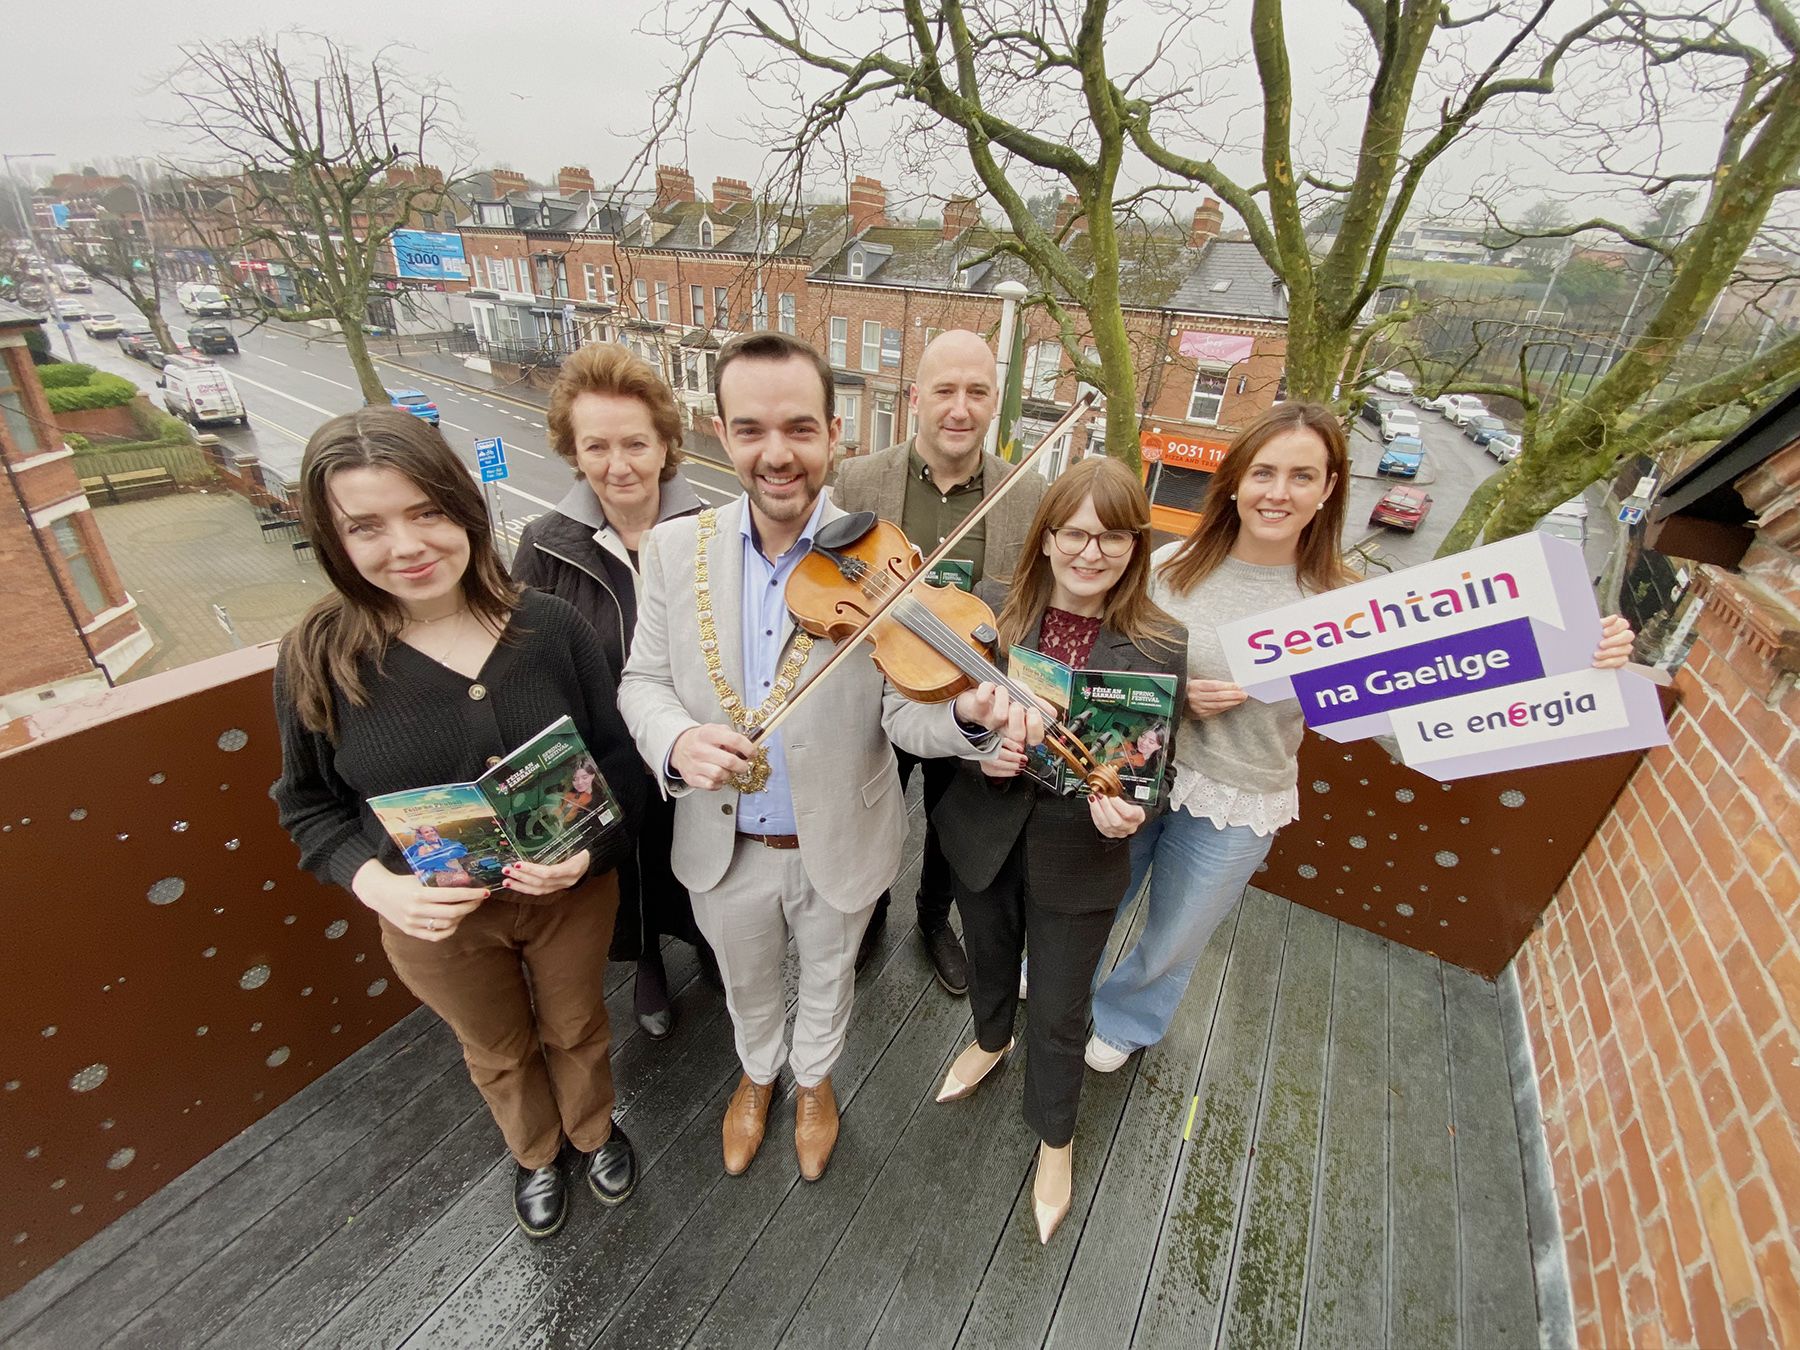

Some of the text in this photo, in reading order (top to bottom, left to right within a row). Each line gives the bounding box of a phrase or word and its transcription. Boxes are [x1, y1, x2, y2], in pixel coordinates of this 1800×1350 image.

[407, 253, 440, 266] 1000
[1165, 454, 1184, 462] PIZZA
[1201, 460, 1219, 468] TREA
[1167, 441, 1204, 459] 9031
[1209, 449, 1226, 462] 11
[1247, 570, 1520, 665] Seachtain
[1315, 648, 1511, 709] na Gaeilge
[1416, 719, 1454, 743] le
